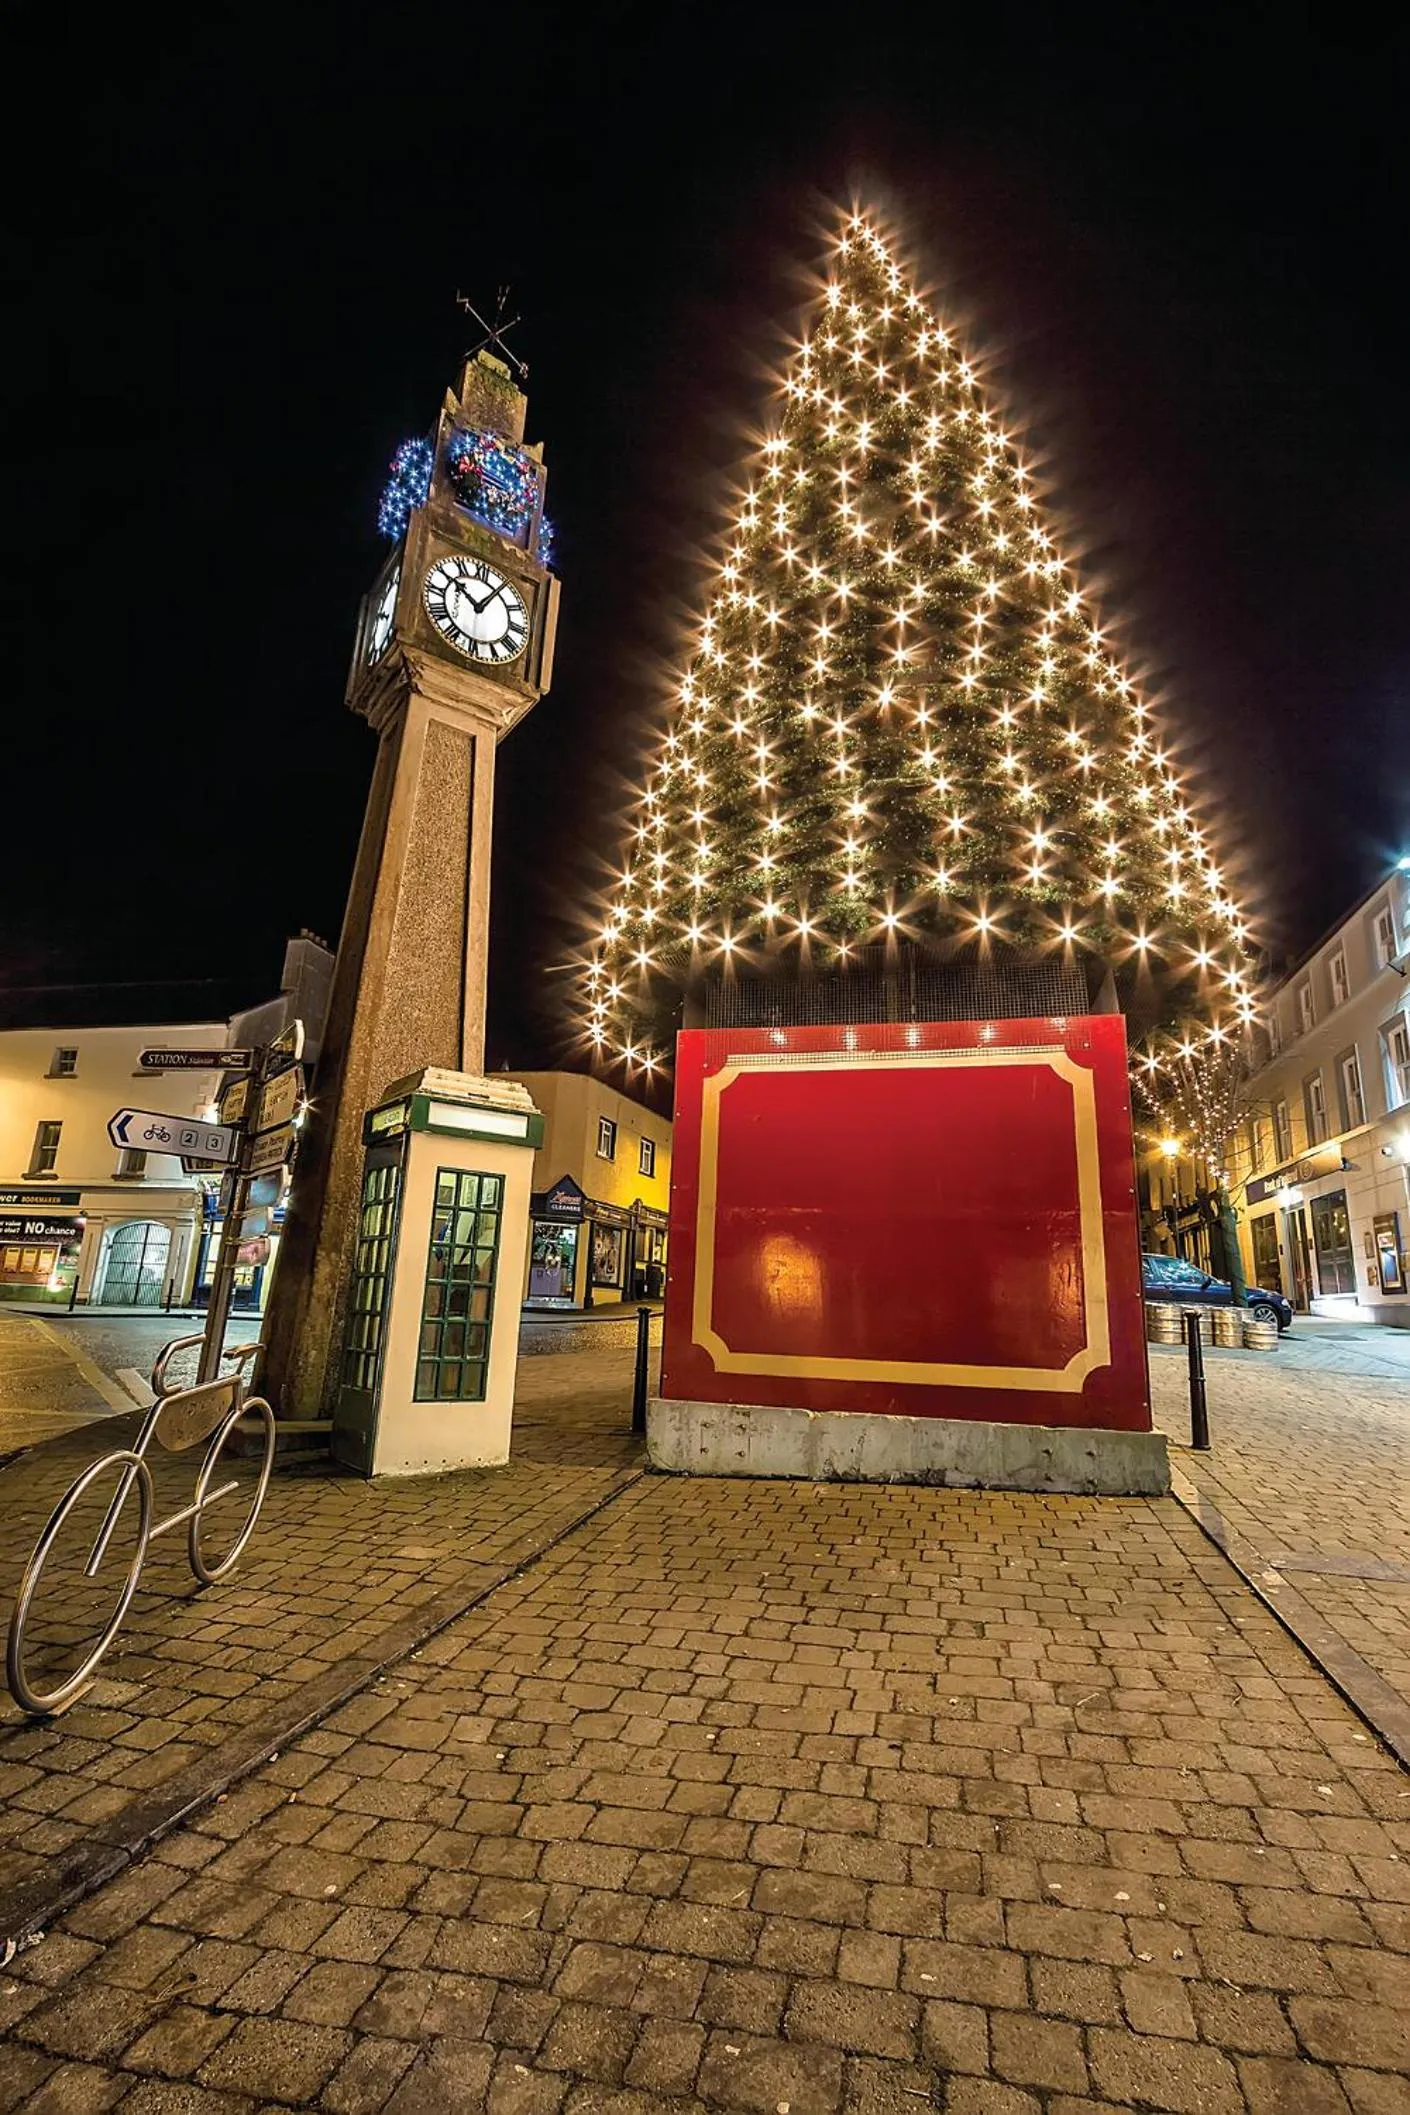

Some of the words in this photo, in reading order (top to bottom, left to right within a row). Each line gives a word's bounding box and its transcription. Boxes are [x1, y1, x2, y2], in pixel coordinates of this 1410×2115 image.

[147, 1053, 188, 1065] STATION
[183, 1132, 194, 1143] 2
[210, 1138, 219, 1148] 3
[550, 1204, 581, 1212] CLEANERS
[24, 1221, 45, 1235] NO
[44, 1226, 77, 1236] chance
